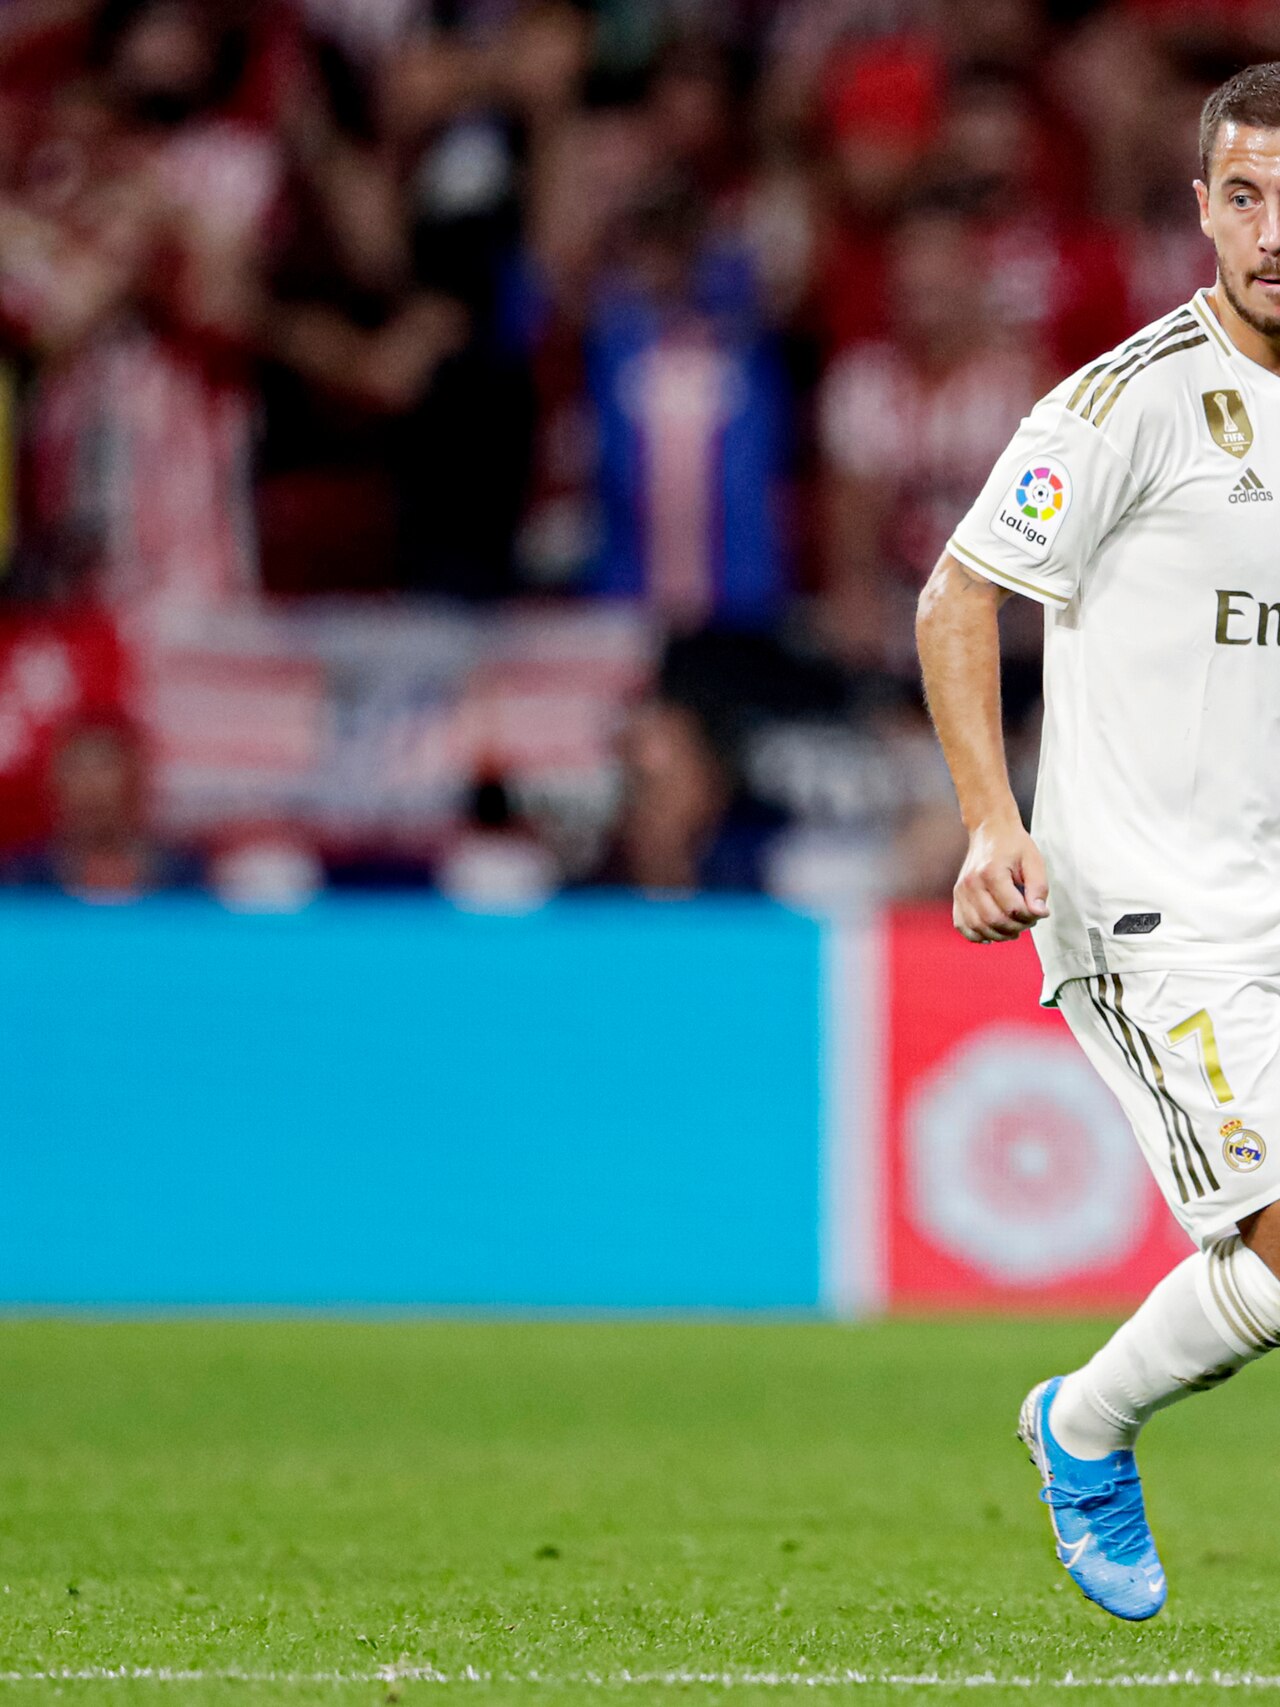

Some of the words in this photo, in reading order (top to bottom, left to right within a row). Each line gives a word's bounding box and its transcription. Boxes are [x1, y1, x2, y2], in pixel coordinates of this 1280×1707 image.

[1228, 489, 1273, 504] adidas
[1000, 509, 1047, 546] LaLiga
[1163, 1008, 1234, 1108] 7
